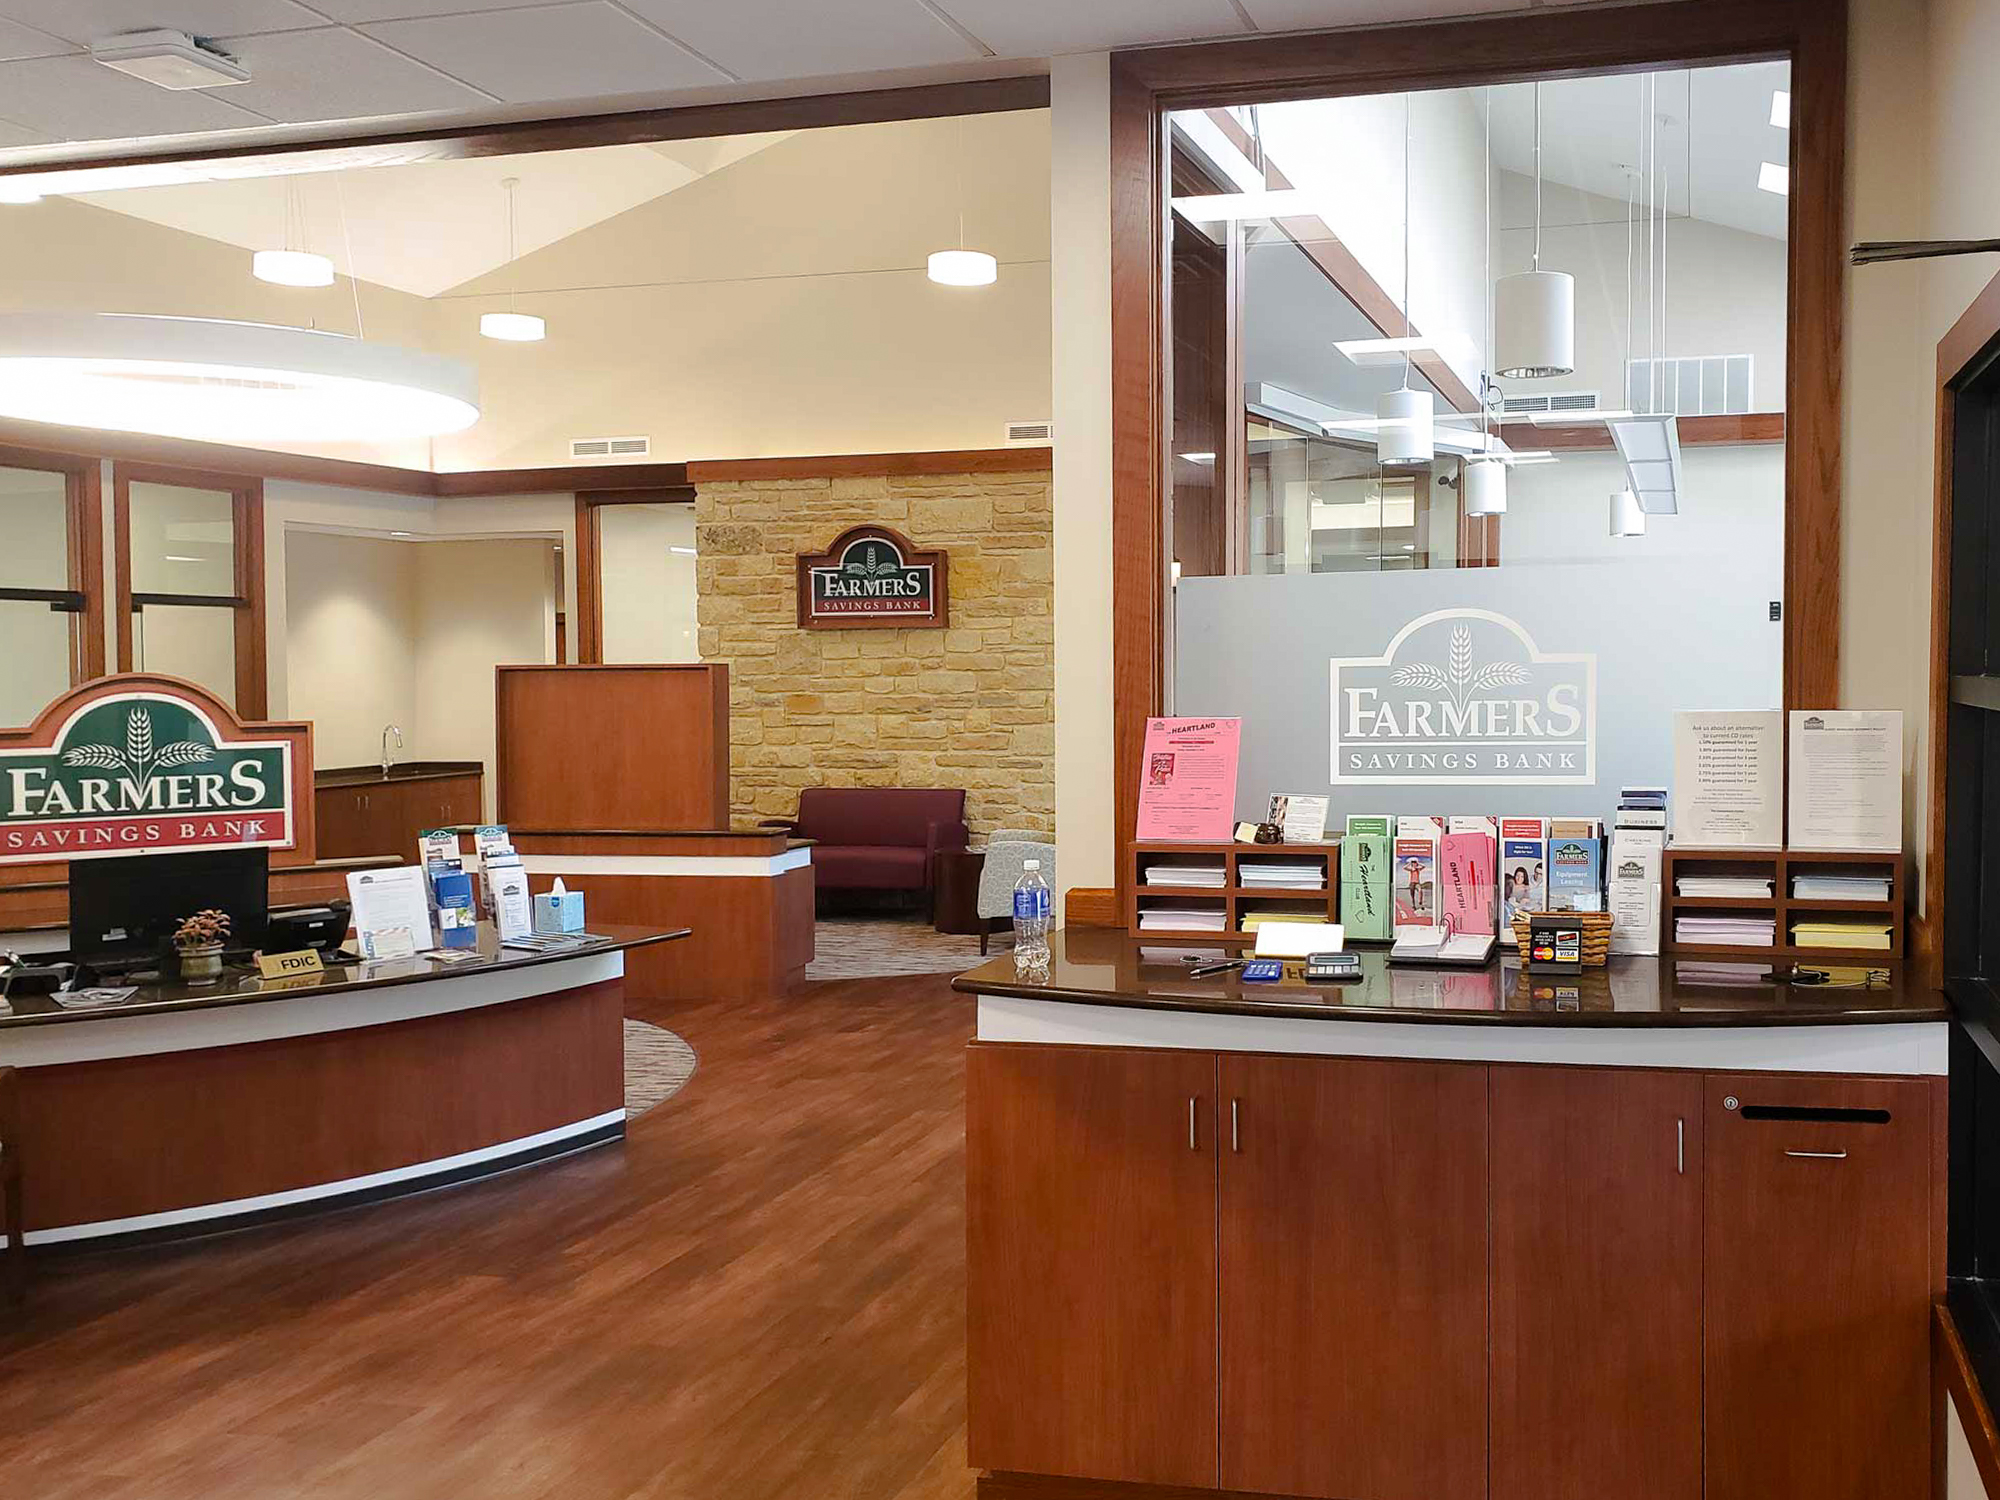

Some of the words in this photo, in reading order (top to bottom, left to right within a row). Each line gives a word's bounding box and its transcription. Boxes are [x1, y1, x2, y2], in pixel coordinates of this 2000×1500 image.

[822, 571, 922, 597] FARMERS
[823, 601, 879, 611] SAVINGS
[886, 600, 921, 610] BANK
[1344, 684, 1582, 738] FARMERS
[1171, 722, 1216, 735] HEARTLAND
[1350, 753, 1478, 769] SAVINGS
[1494, 752, 1576, 769] BANK
[6, 759, 266, 818] FARMERS
[7, 824, 162, 849] SAVINGS
[179, 819, 266, 840] BANK
[1556, 852, 1588, 860] FARMERS
[1359, 864, 1376, 917] Heartland
[1450, 862, 1466, 908] HEARTLAND
[281, 956, 316, 970] FDIC
